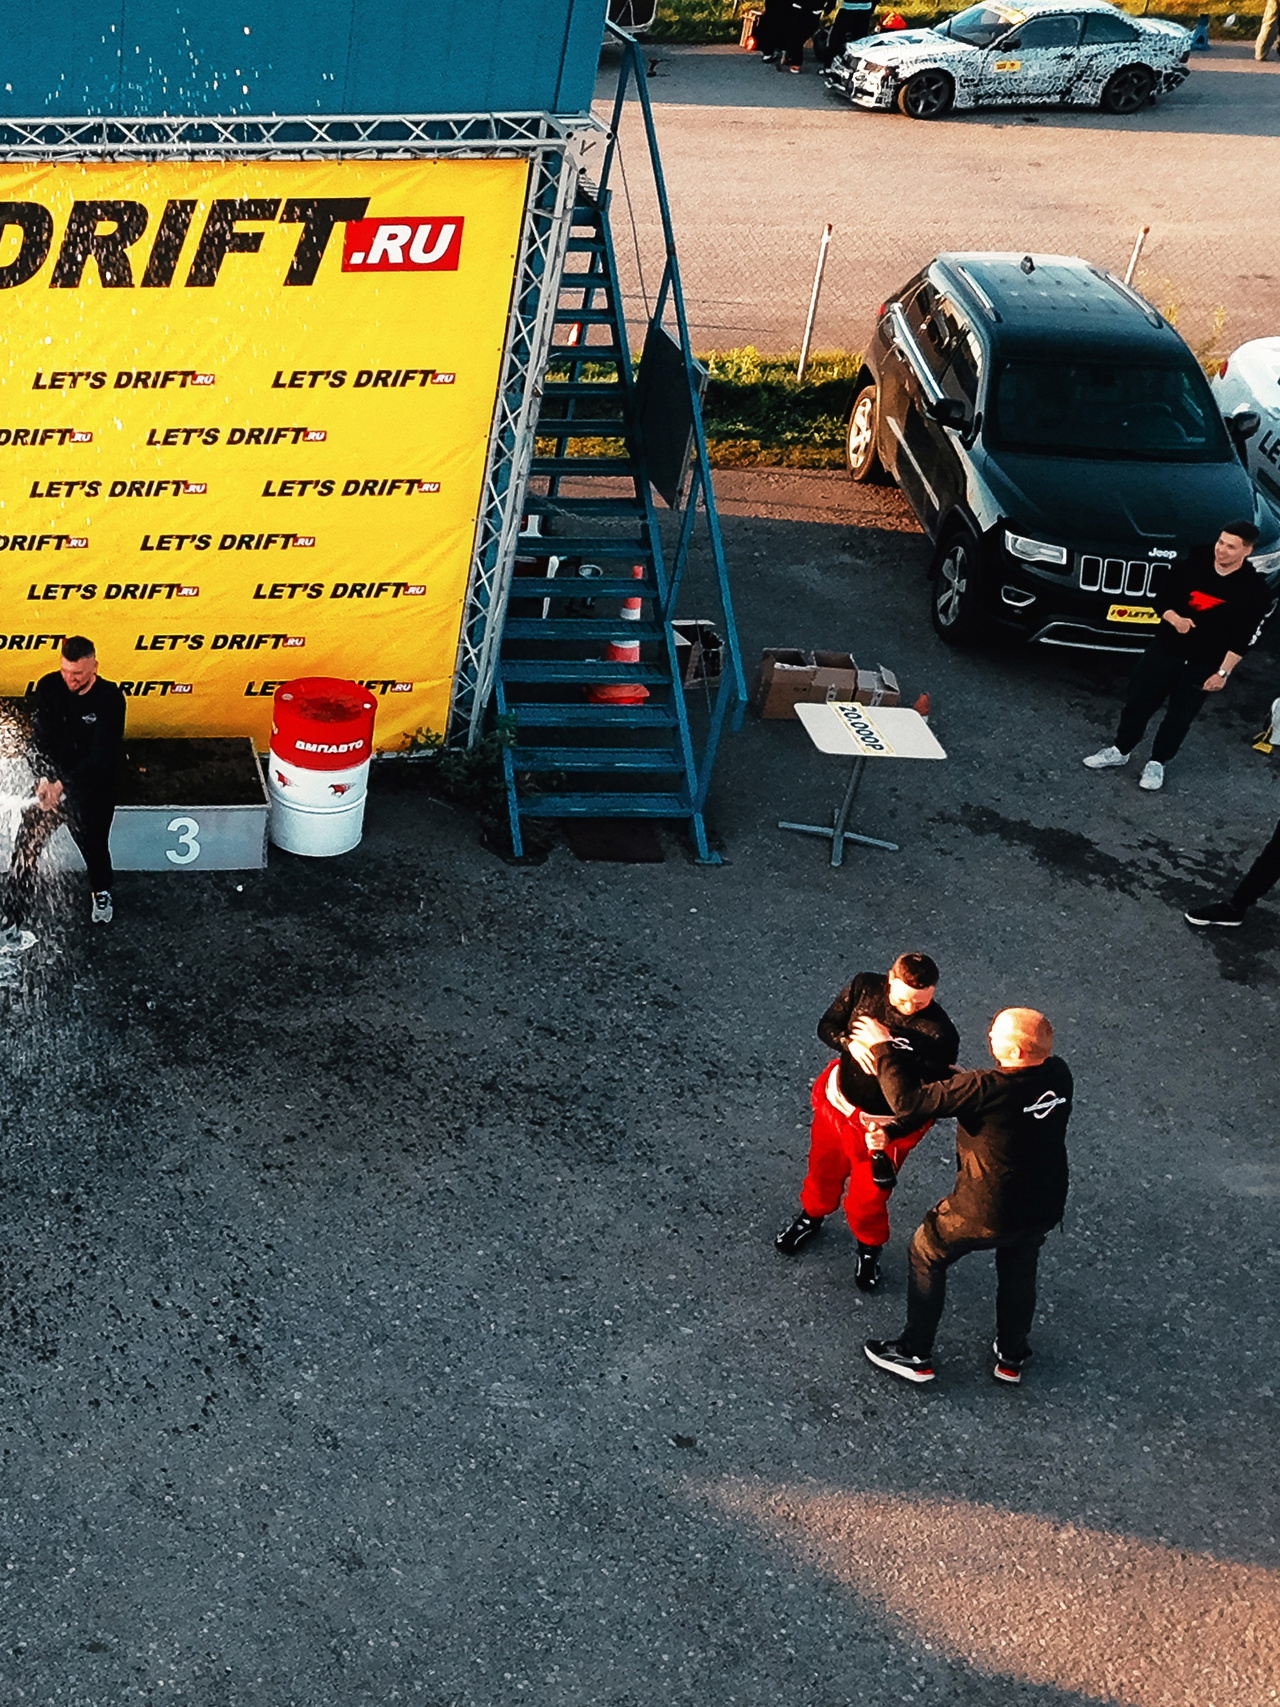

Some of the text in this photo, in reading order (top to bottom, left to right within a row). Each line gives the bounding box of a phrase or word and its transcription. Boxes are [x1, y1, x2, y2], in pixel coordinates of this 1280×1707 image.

[32, 372, 107, 389] LET'S
[272, 371, 346, 388] LET'S
[147, 428, 220, 445] LET'S
[30, 481, 102, 498] LET'S
[262, 480, 335, 496] LET'S
[140, 535, 212, 550] LET'S
[1148, 548, 1177, 559] Jeep
[27, 584, 97, 600] LET'S
[253, 583, 324, 599] LET'S
[135, 635, 204, 650] LET'S
[165, 817, 201, 865] 3
